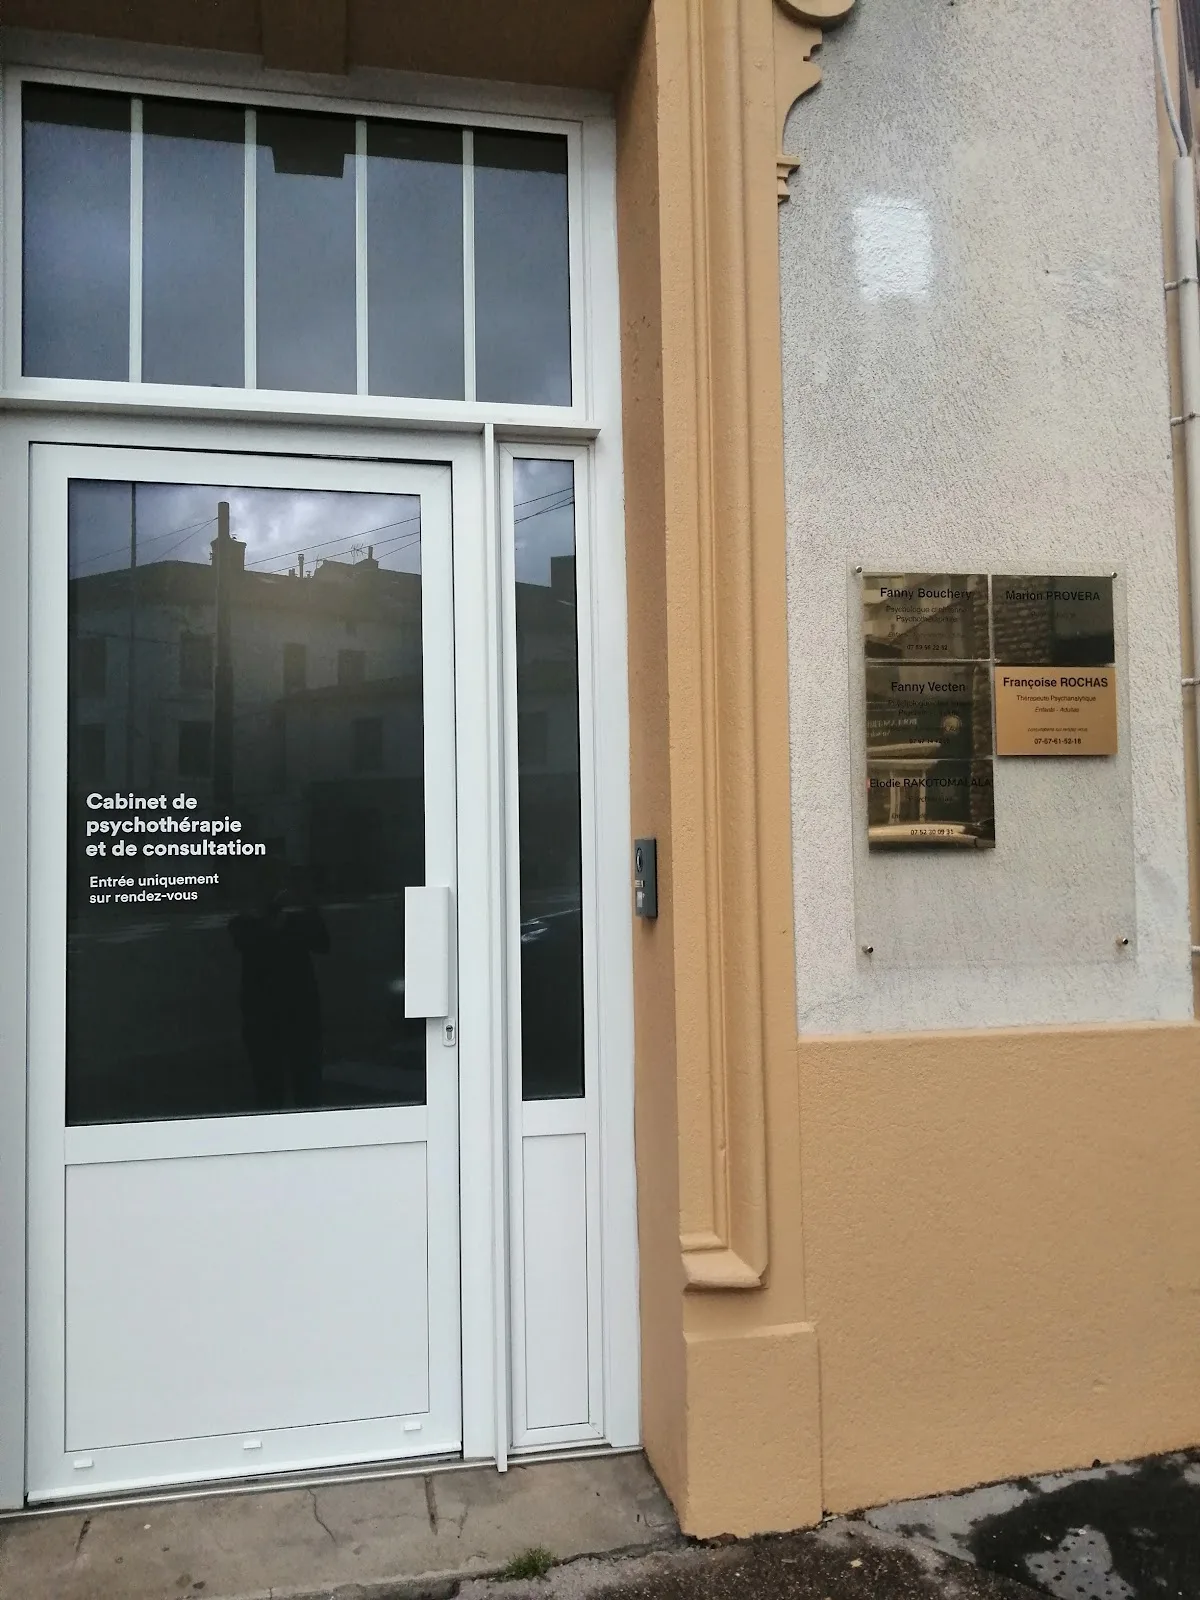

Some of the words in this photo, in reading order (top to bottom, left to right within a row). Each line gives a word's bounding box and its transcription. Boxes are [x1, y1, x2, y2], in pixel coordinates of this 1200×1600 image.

[880, 587, 914, 600] Fanny
[918, 588, 972, 600] Bouchery
[1006, 590, 1043, 601] Marion
[1046, 591, 1101, 601] PROVERA
[891, 681, 925, 694] Fanny
[927, 681, 966, 692] Vecten
[1003, 677, 1057, 689] Françoise
[1060, 677, 1109, 688] ROCHAS
[869, 778, 901, 788] Elodie
[86, 793, 167, 810] Cabinet
[172, 793, 198, 810] de
[86, 816, 242, 836] psychothérapie
[85, 841, 106, 856] et
[111, 840, 137, 856] de
[142, 839, 266, 856] consultation
[89, 875, 134, 888] Entrée
[138, 873, 219, 888] uniquement
[89, 893, 111, 904] sur
[115, 890, 198, 903] rendez-vous
